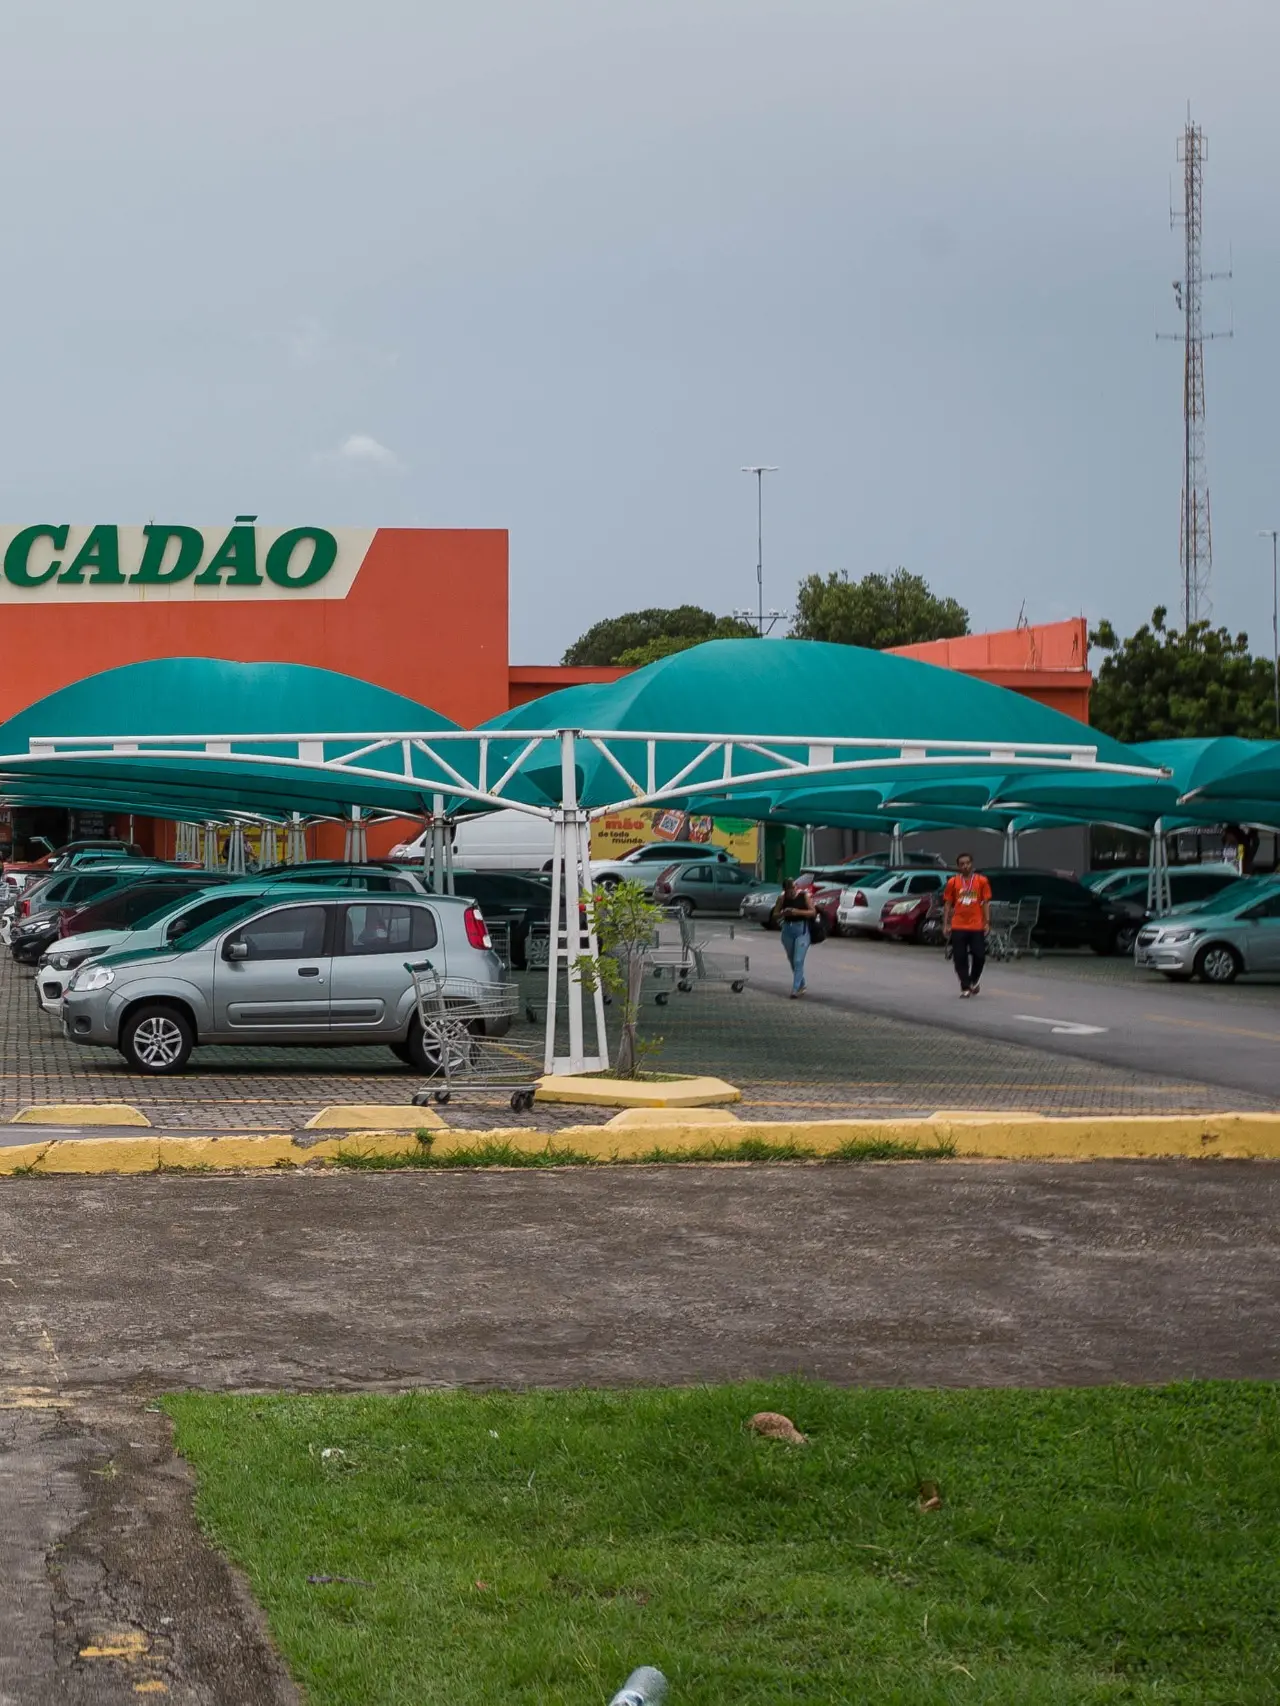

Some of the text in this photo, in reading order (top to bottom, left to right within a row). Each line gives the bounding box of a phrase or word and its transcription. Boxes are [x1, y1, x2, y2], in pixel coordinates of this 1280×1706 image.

[605, 817, 645, 830] mão
[598, 830, 629, 838] de todo
